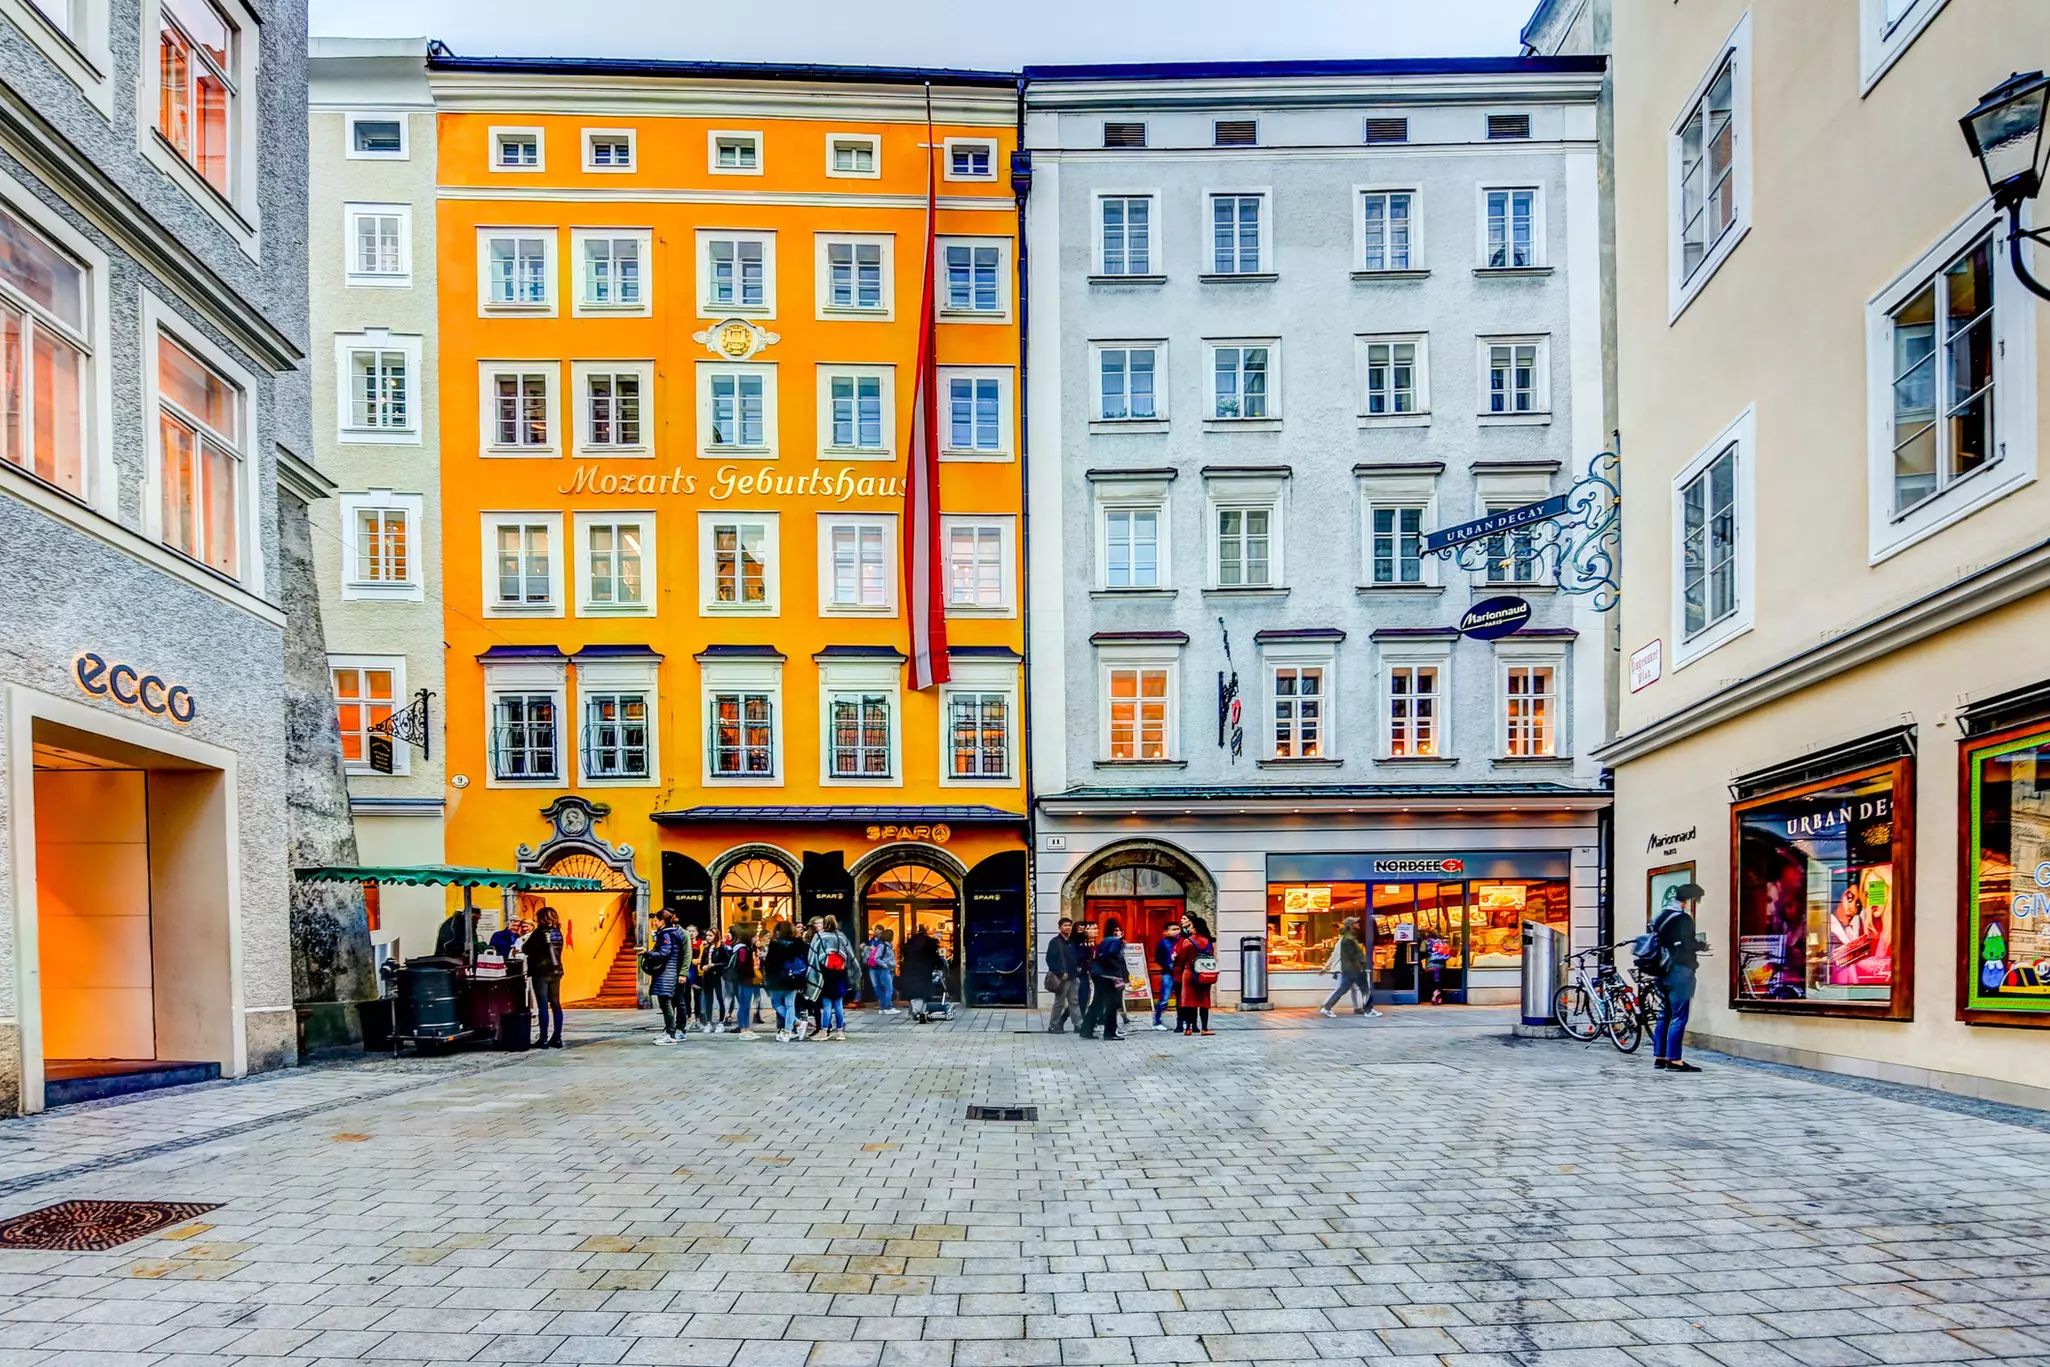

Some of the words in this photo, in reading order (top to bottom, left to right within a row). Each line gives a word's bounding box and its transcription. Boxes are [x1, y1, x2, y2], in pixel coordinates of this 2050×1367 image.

[558, 465, 697, 495] Mozarts
[1446, 520, 1493, 541] URBAN
[1498, 505, 1545, 527] DECAY
[1461, 602, 1527, 629] Marionnaud
[77, 652, 196, 722] ecco
[1786, 806, 1853, 835] URBAN
[1859, 799, 1893, 820] DE
[866, 825, 931, 841] SPAR
[1646, 825, 1696, 855] Marionnaud
[1374, 860, 1440, 872] NORDSEE
